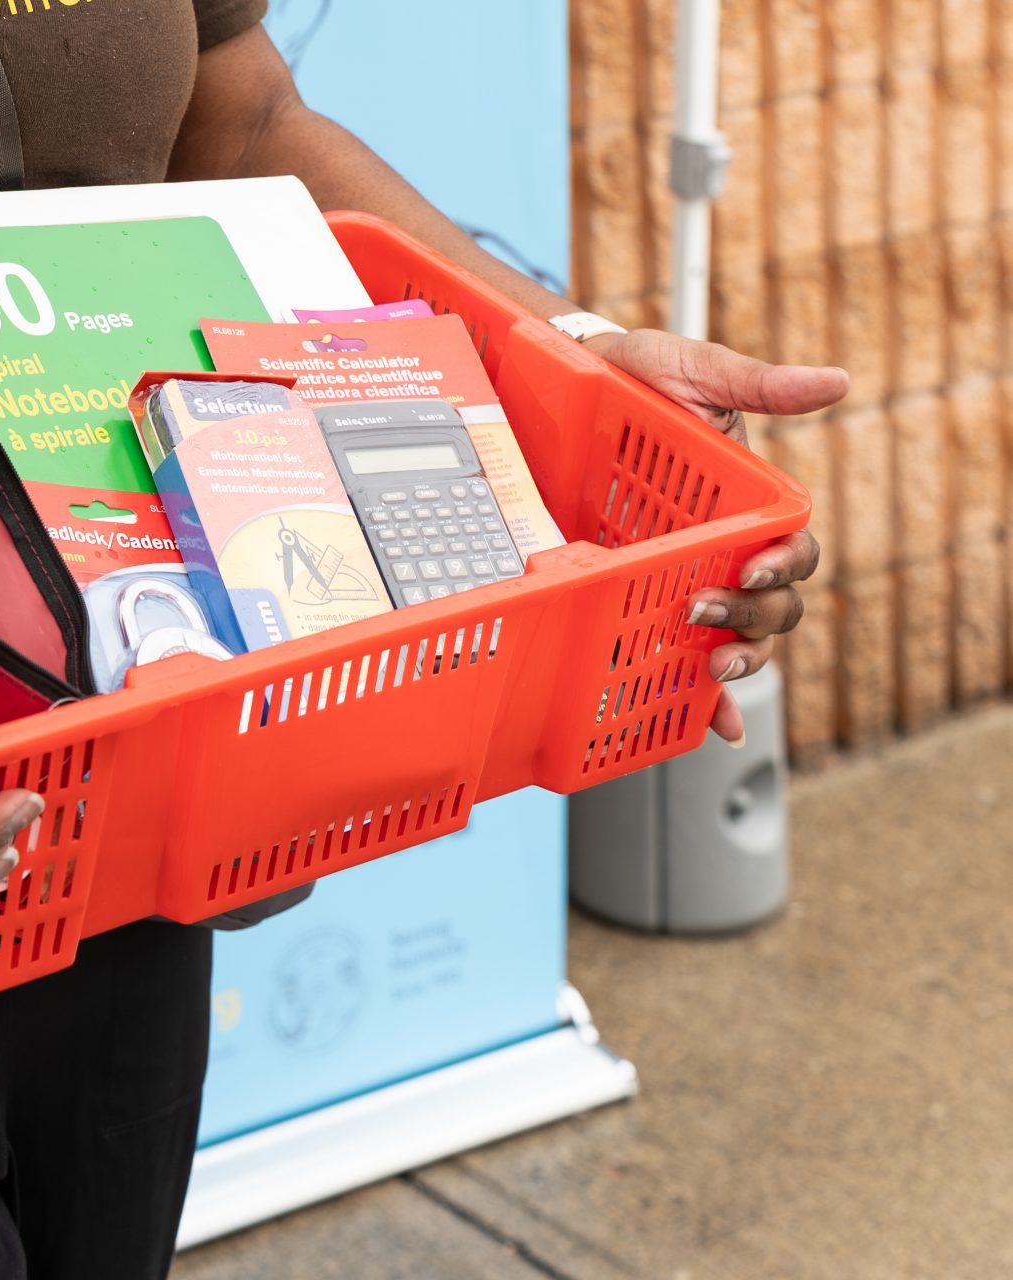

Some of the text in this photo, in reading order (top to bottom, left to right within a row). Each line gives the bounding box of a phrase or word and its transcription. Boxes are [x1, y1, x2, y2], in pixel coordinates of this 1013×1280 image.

[63, 309, 134, 334] Pages
[259, 354, 421, 370] Scientific Calculator
[349, 369, 443, 384] scientifique
[193, 398, 284, 415] Selectum
[334, 416, 388, 426] Selectum
[9, 422, 111, 455] à spirale
[233, 429, 288, 447] 10 pcs
[210, 450, 302, 464] Mathematical Set
[197, 466, 249, 478] Ensemble
[281, 485, 326, 497] conjunto
[399, 560, 461, 577] 7 8 9
[412, 590, 423, 601] 4
[313, 613, 339, 623] strong
